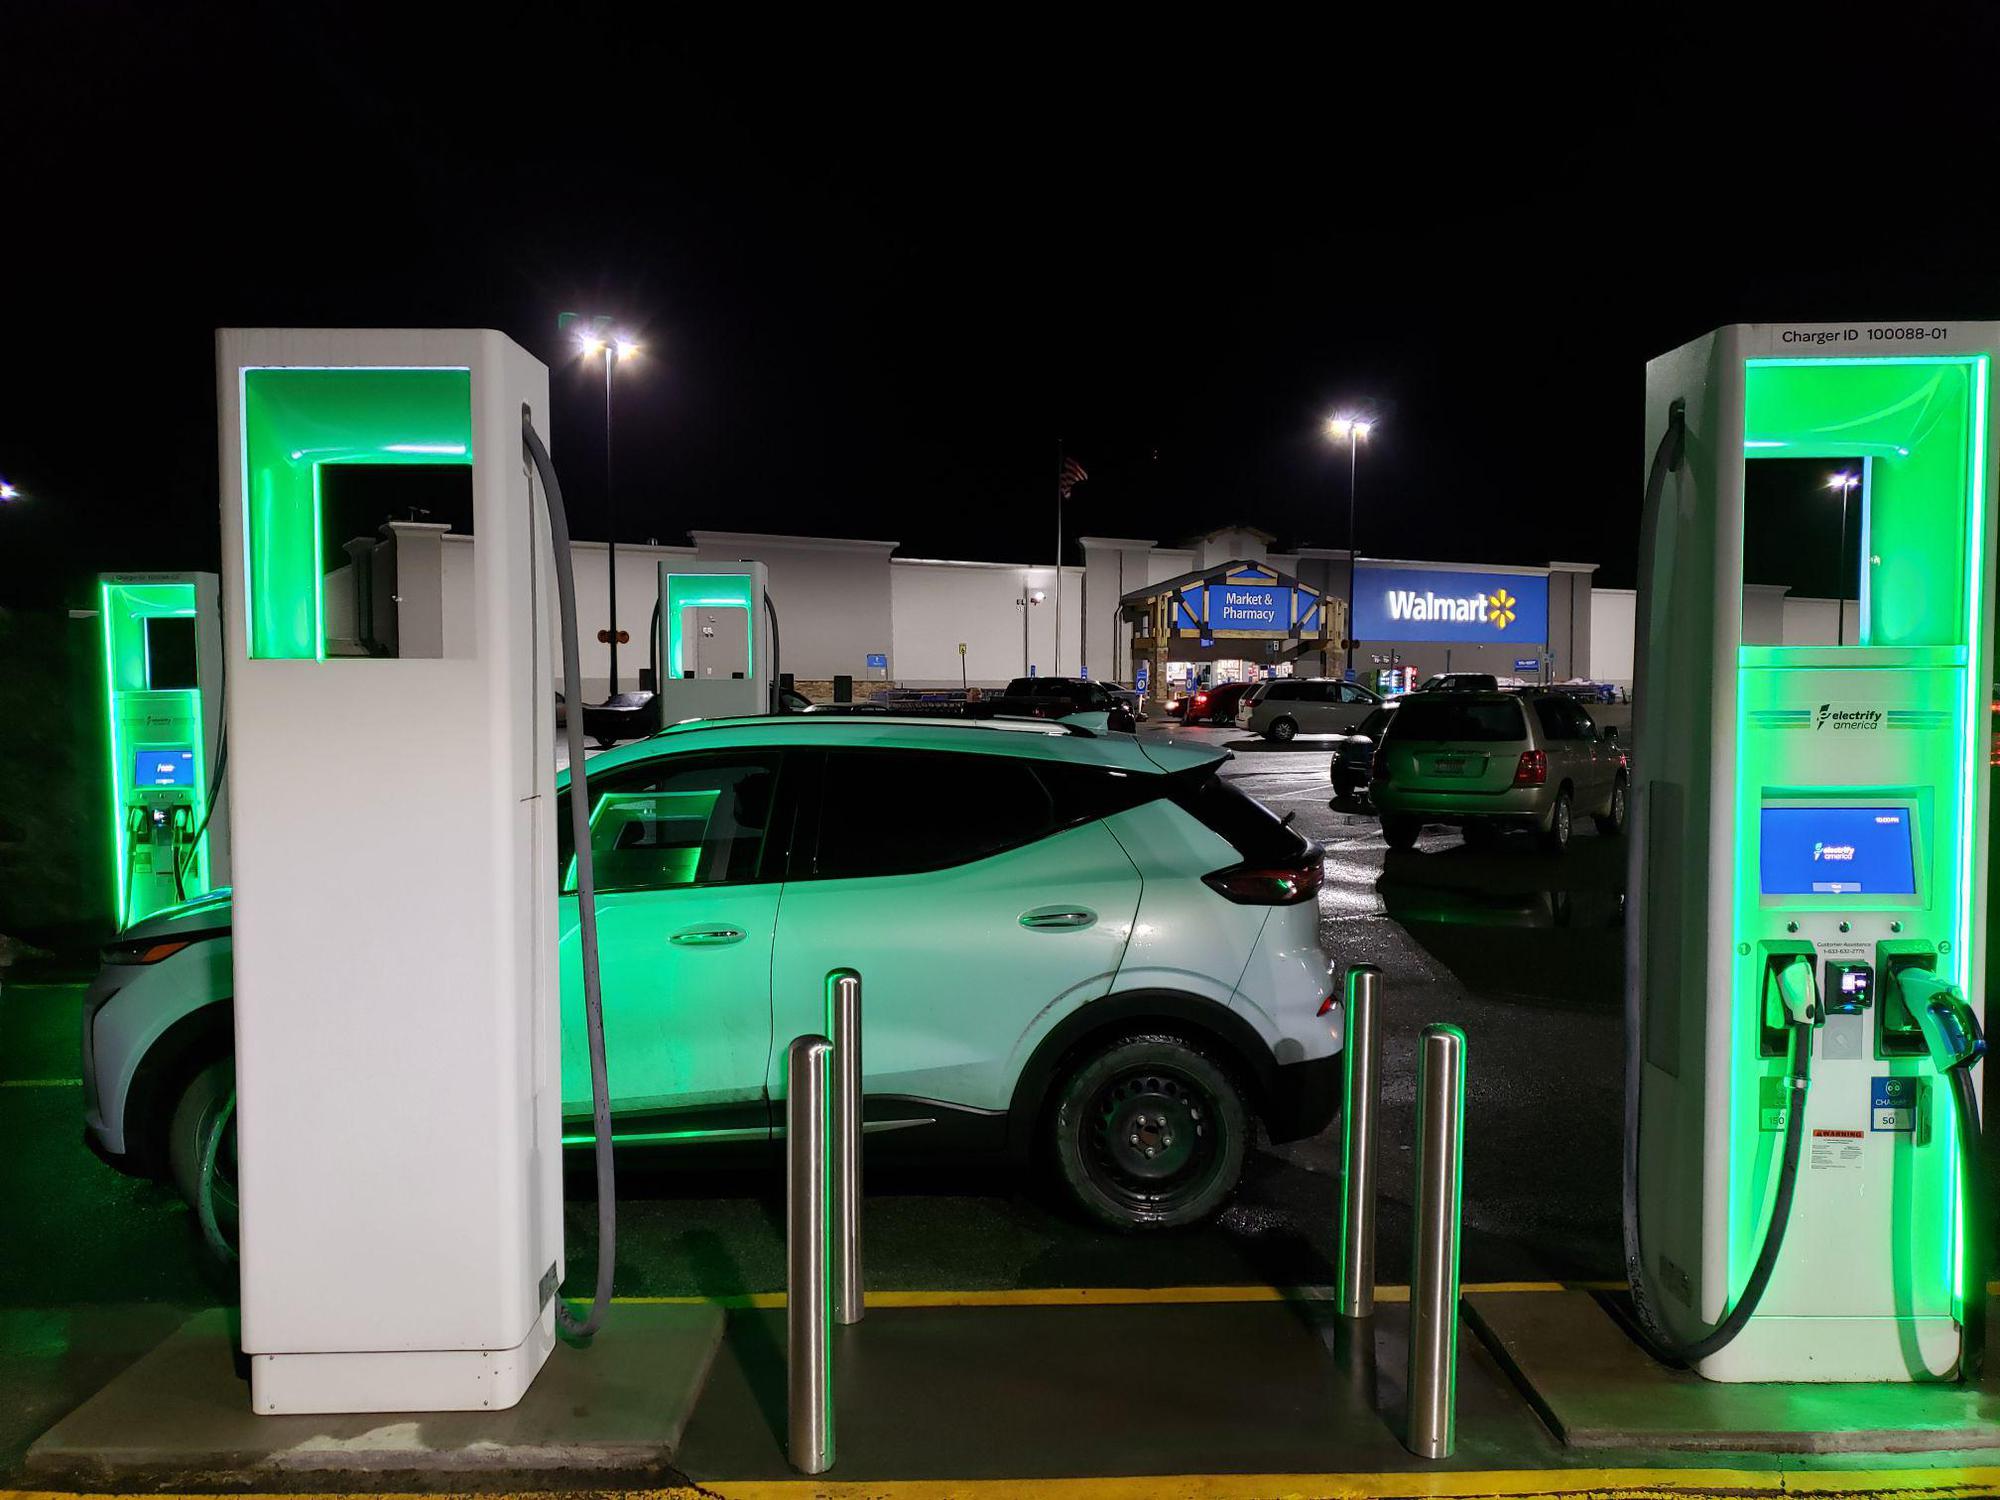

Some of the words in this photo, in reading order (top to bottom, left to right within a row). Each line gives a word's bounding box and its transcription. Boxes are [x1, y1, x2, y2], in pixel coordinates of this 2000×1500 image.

[1782, 331, 1840, 344] Charger
[1843, 330, 1859, 341] ID
[1867, 328, 1948, 340] 100088-01
[1226, 592, 1262, 605] Market
[1264, 593, 1273, 605] &
[1387, 589, 1488, 622] Walmart
[1223, 606, 1275, 622] Pharmacy
[1832, 710, 1882, 722] electrify
[1833, 721, 1878, 730] america
[1882, 1116, 1895, 1125] 50
[1822, 1130, 1862, 1138] WARNING
